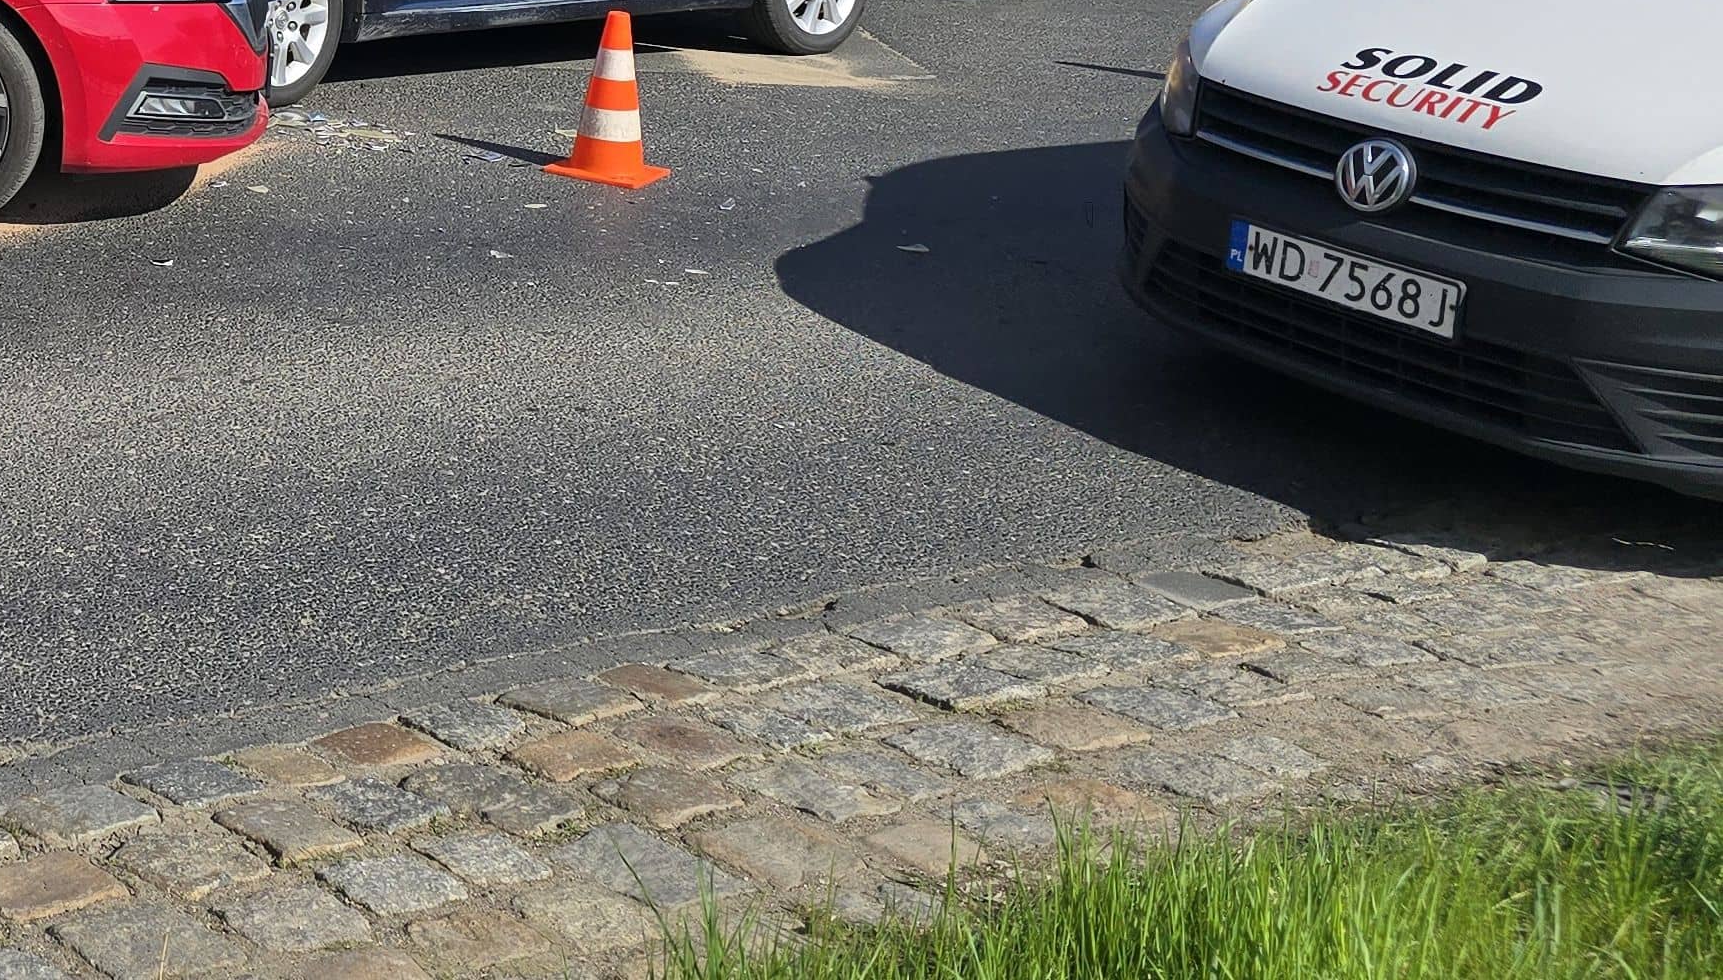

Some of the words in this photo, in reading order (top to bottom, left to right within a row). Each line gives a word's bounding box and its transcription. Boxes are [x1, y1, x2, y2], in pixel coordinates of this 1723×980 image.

[1316, 70, 1517, 130] SECURITY
[1340, 47, 1543, 104] SOLID
[1230, 249, 1243, 262] PL
[1252, 231, 1306, 282] WD
[1318, 252, 1449, 328] 7568J
